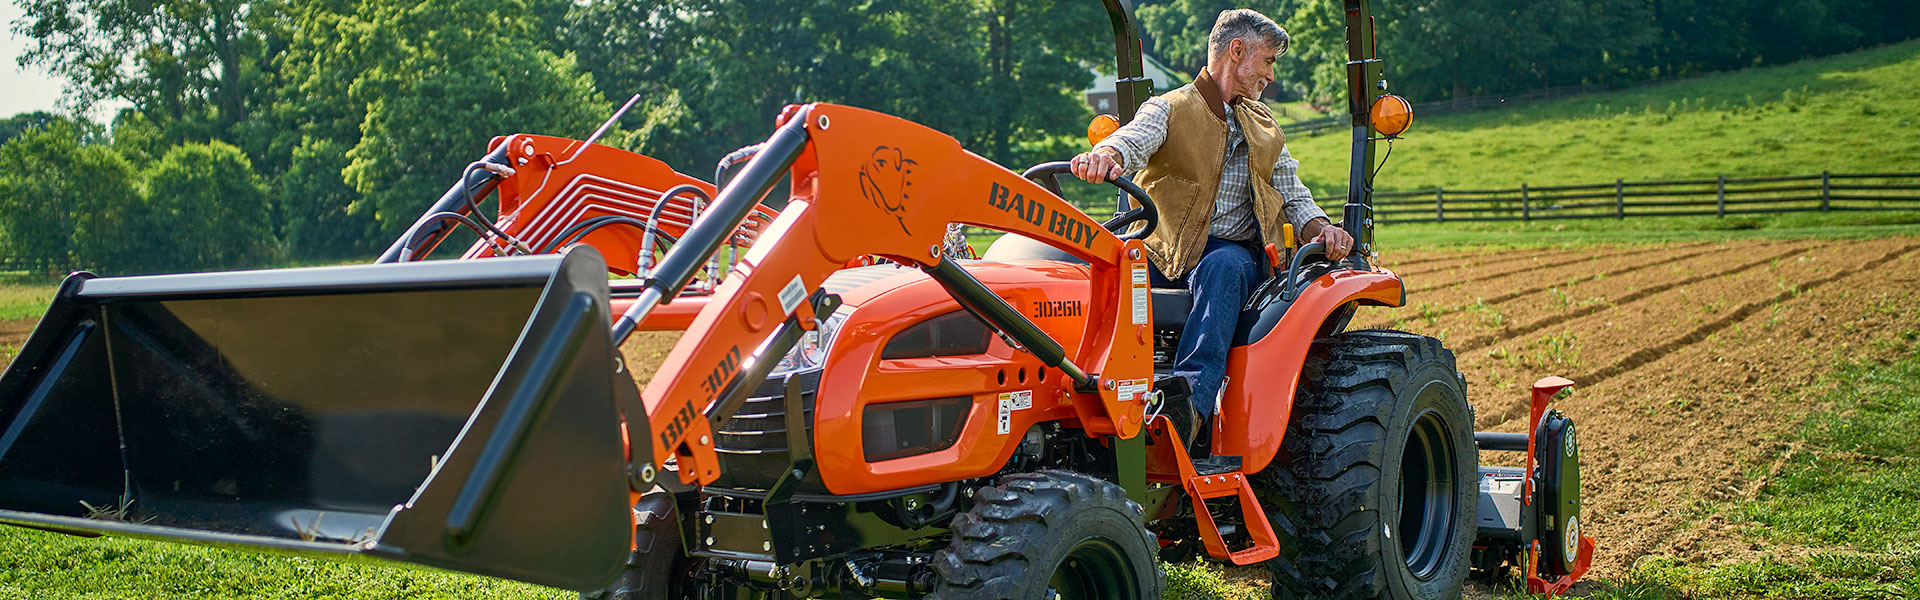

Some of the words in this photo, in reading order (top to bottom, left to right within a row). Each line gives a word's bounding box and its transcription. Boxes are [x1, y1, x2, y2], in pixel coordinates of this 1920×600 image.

[988, 181, 1045, 226] BAD
[1048, 209, 1099, 249] BOY
[1033, 300, 1081, 318] 3026H
[661, 399, 702, 452] BBL
[701, 345, 742, 402] 300
